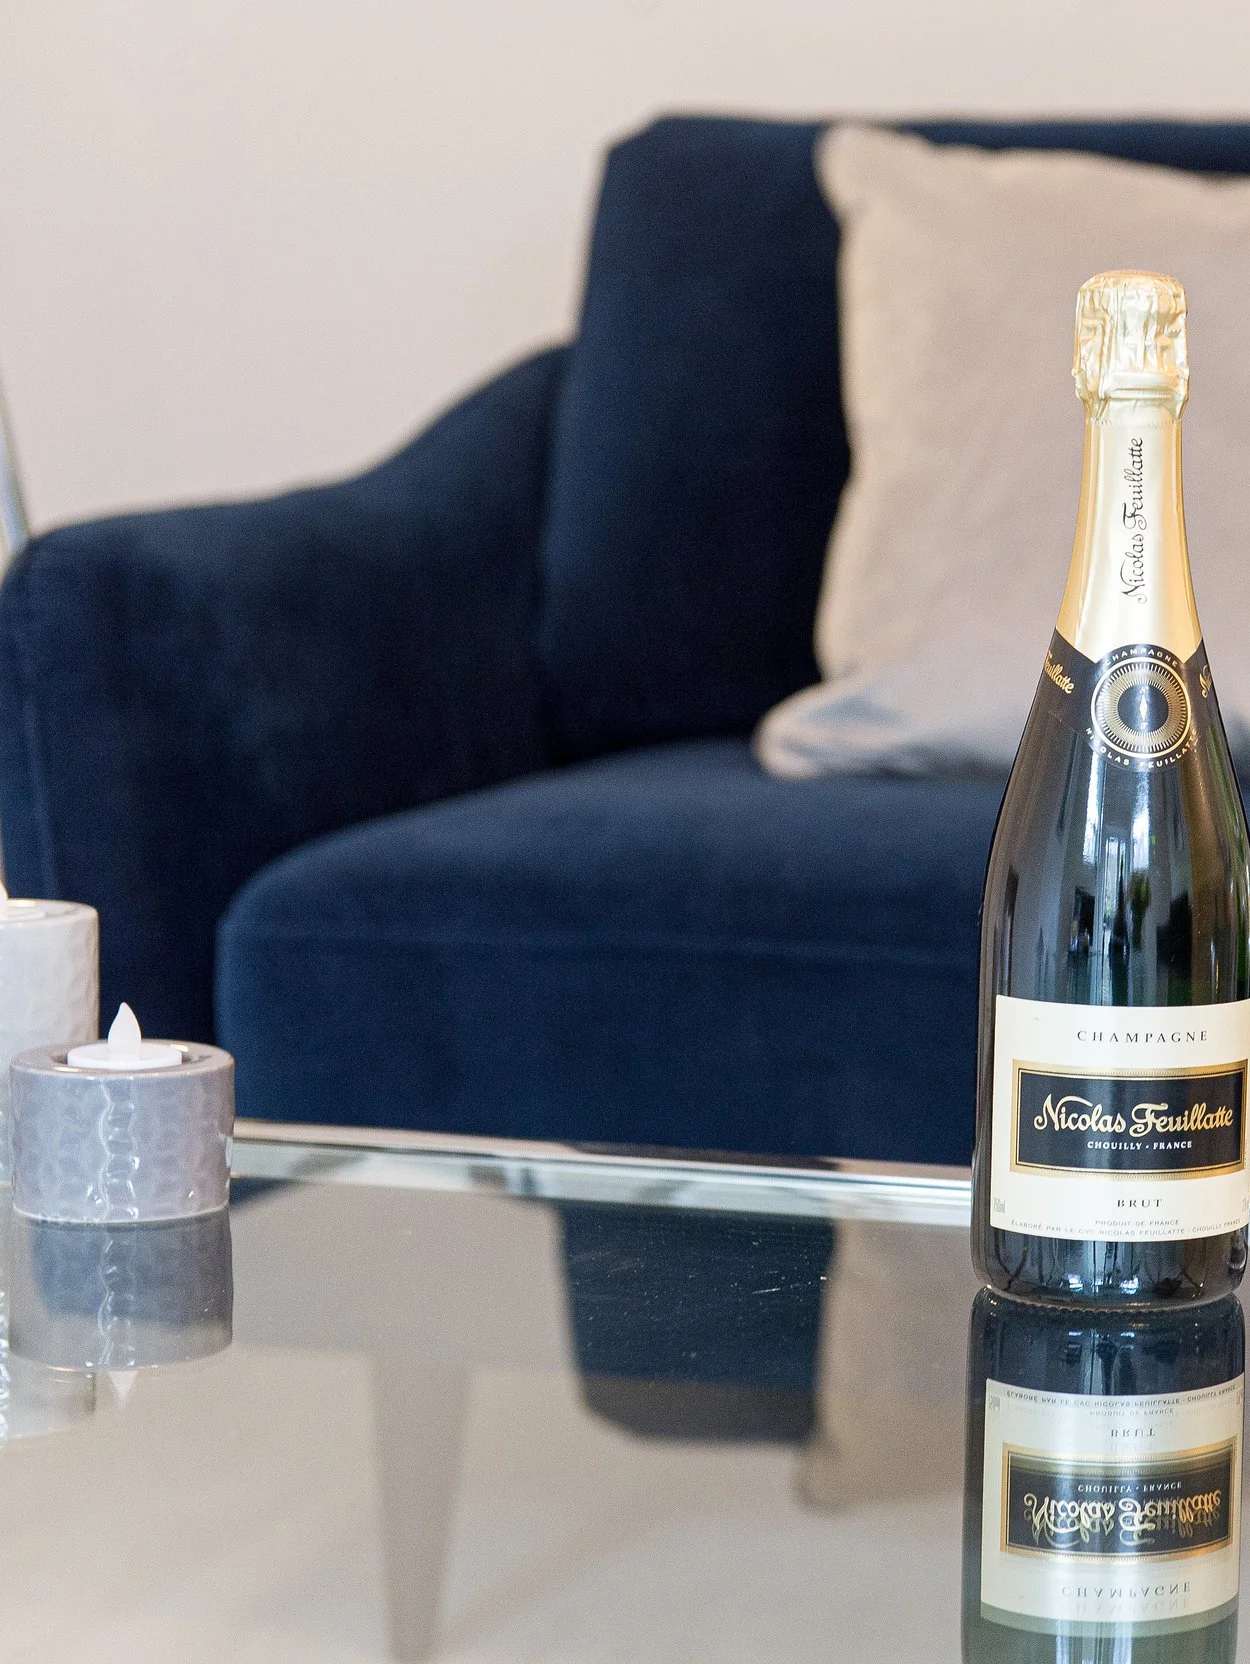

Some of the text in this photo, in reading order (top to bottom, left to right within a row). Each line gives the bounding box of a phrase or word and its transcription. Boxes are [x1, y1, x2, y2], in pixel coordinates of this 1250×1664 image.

[1119, 438, 1147, 604] Nicolas Feuillatte
[1104, 647, 1178, 667] CHAMPAGNE
[1085, 727, 1130, 766] NICOLAS
[1077, 1030, 1208, 1043] CHAMPAGNE
[1033, 1094, 1233, 1138] Nicolas Feuillatte
[1087, 1140, 1193, 1151] CHOUILLY FRANCE
[1116, 1199, 1163, 1210] BRUT
[1046, 1225, 1061, 1233] PAR
[1099, 1229, 1135, 1237] NICOLAS
[1139, 1228, 1185, 1236] FEUILLATTE
[1192, 1223, 1222, 1233] CHOUILLY
[1149, 1219, 1180, 1227] FRANCE
